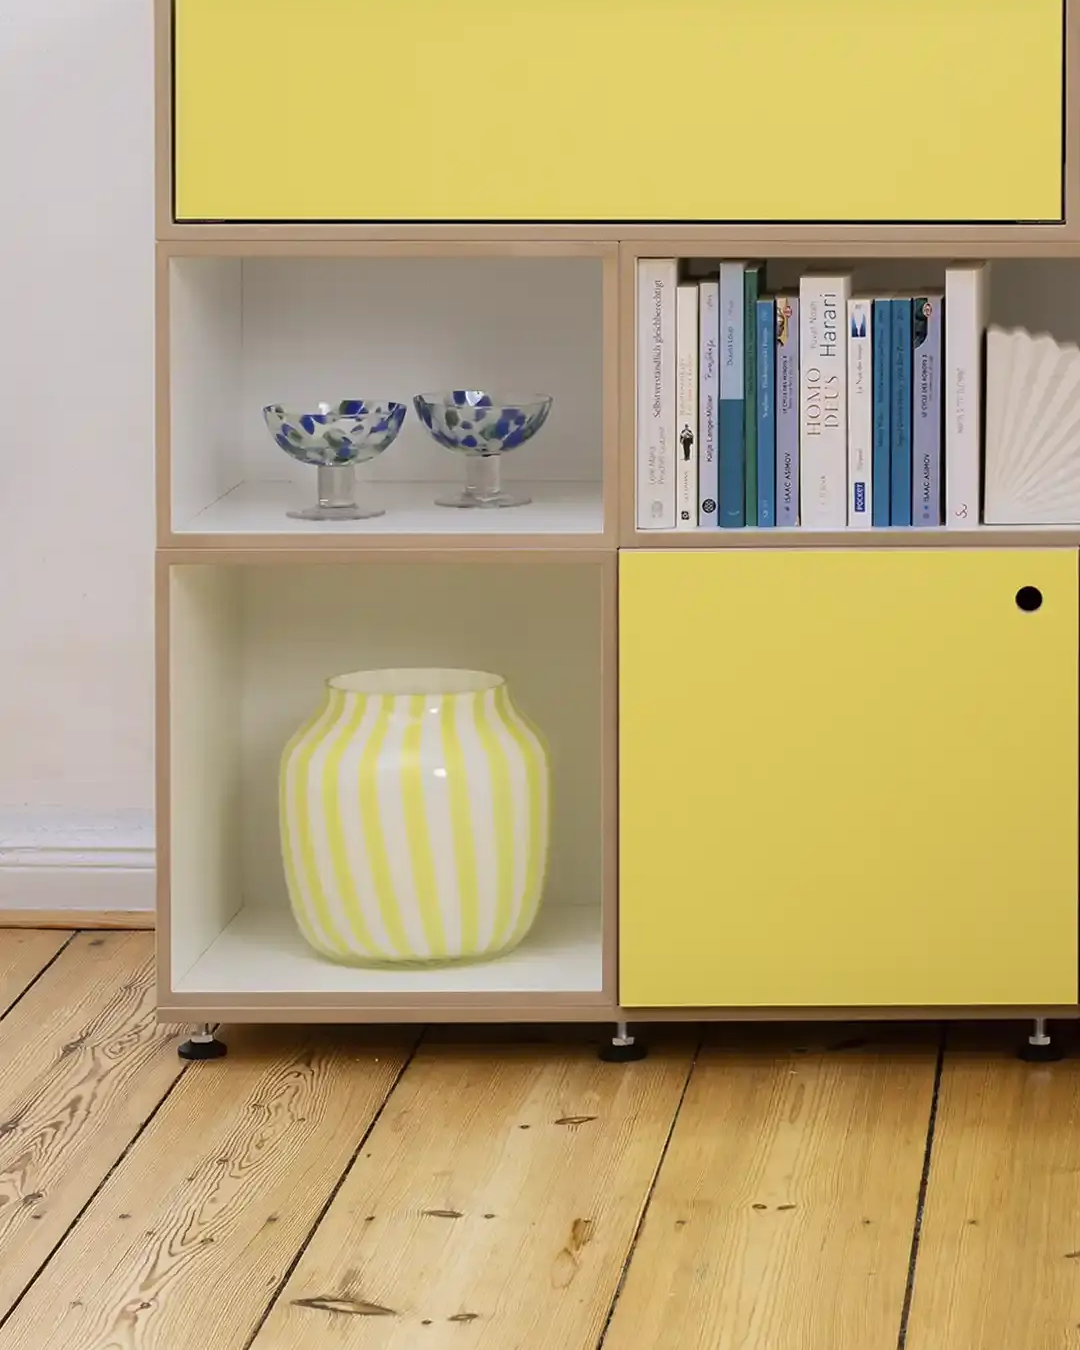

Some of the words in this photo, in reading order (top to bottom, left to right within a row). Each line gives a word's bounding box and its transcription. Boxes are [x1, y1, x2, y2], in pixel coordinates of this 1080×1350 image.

[653, 279, 664, 344] gleichberechtigt
[810, 300, 818, 322] Noah
[819, 293, 836, 358] Harari
[653, 346, 662, 418] Selbstverständlich
[806, 367, 821, 437] HOMO
[824, 375, 839, 428] DEUS
[705, 394, 713, 442] Lange-Müller
[783, 452, 791, 480] ASIMOV
[922, 453, 930, 480] ASIMOV
[783, 482, 791, 503] ISAAC
[856, 483, 864, 511] POCKET
[922, 481, 930, 503] ISAAC
